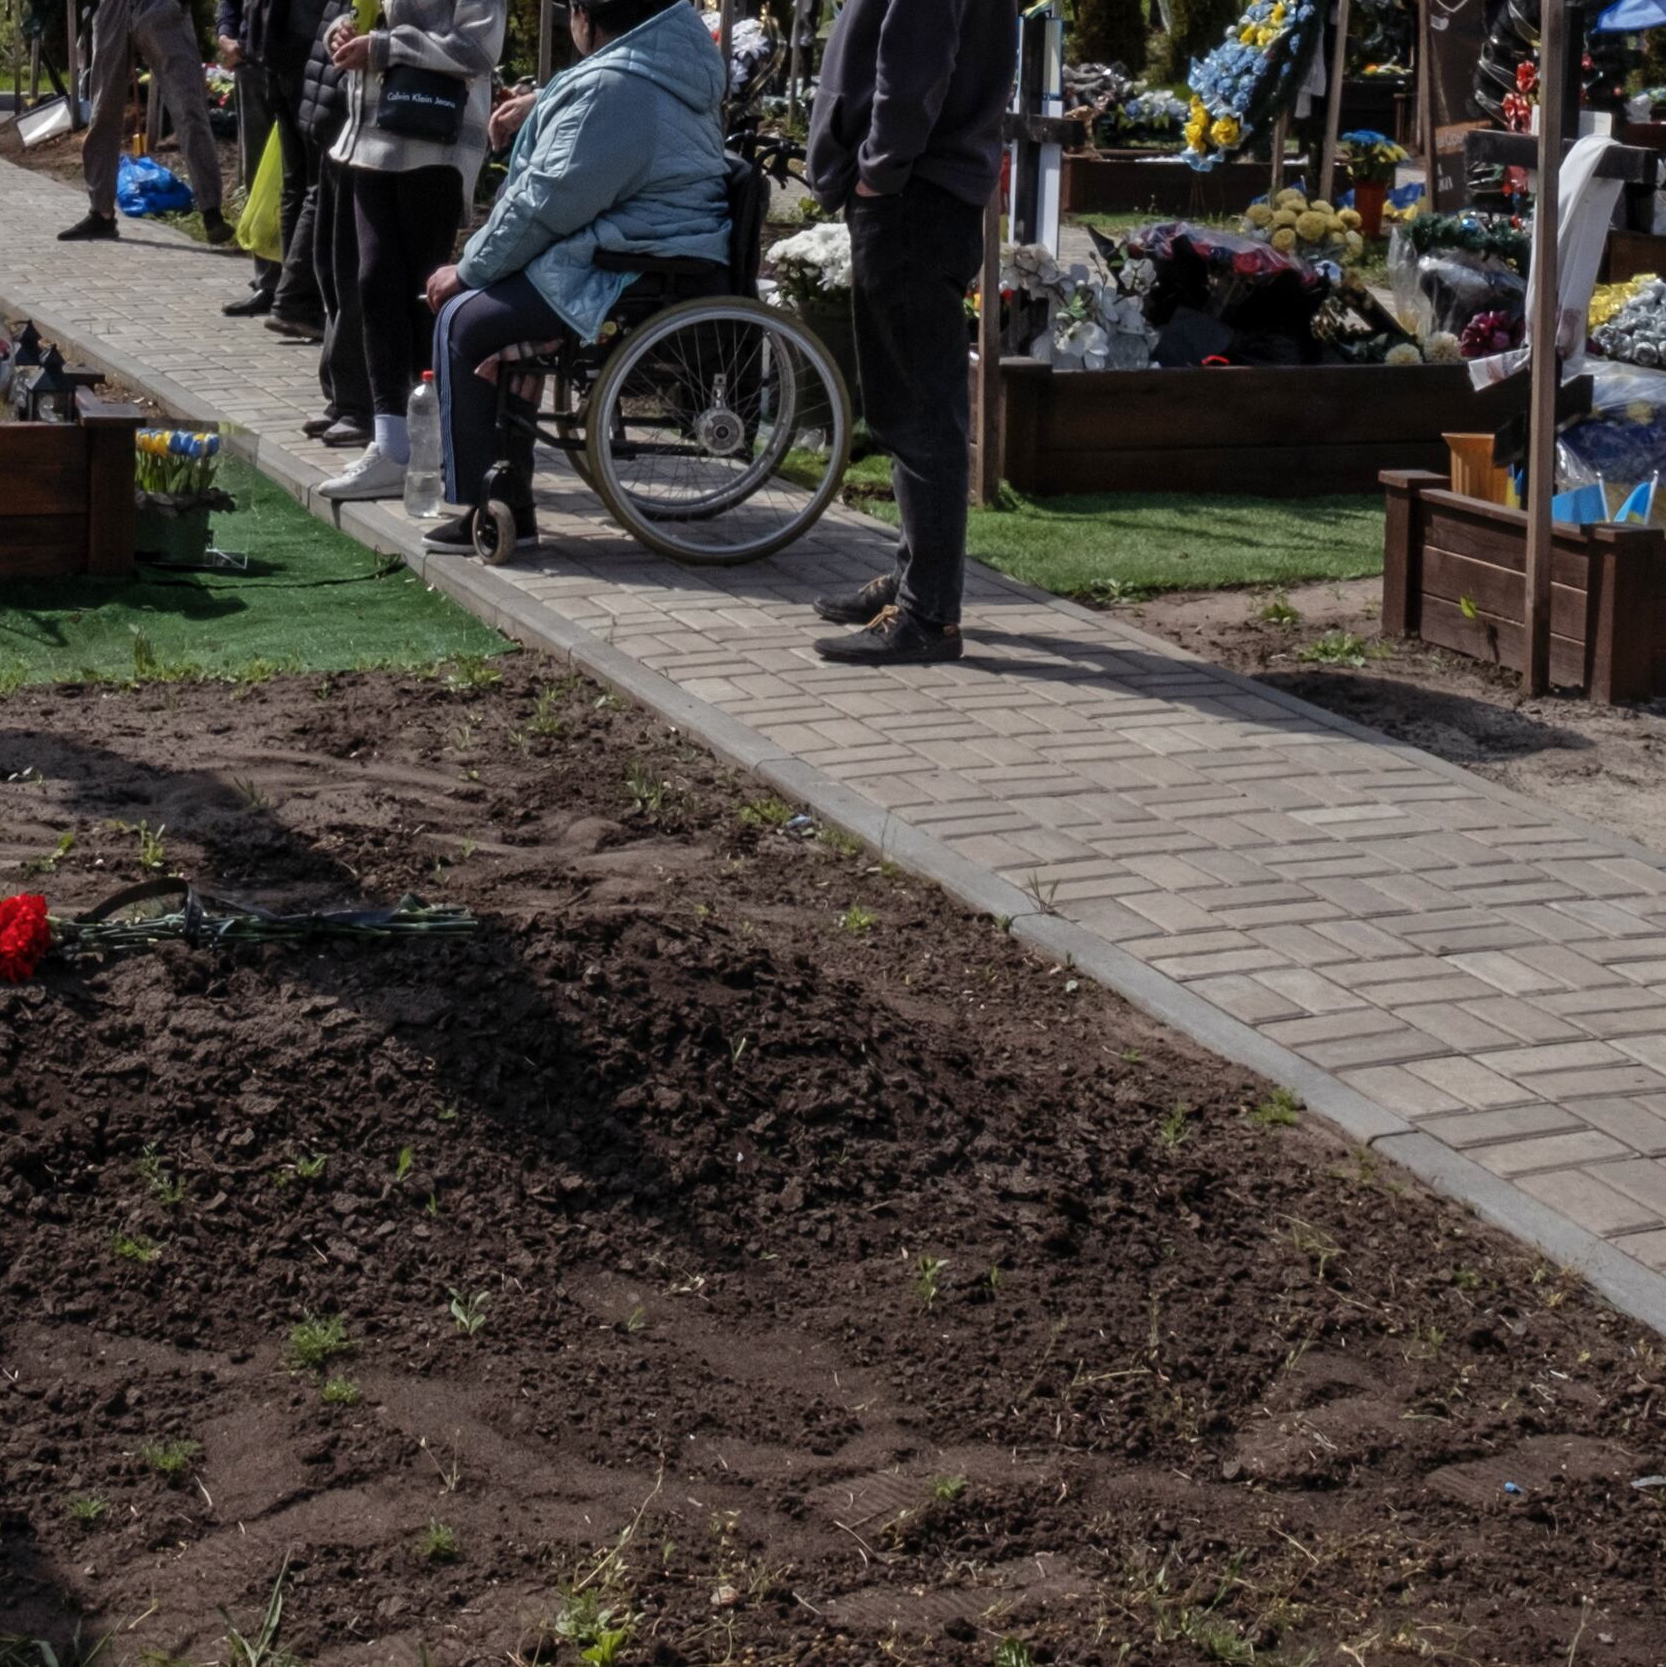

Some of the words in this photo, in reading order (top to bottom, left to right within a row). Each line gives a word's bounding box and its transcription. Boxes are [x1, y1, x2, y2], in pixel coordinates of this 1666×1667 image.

[387, 91, 410, 102] Calvin
[412, 93, 433, 104] Klein
[434, 97, 456, 109] Jeans
